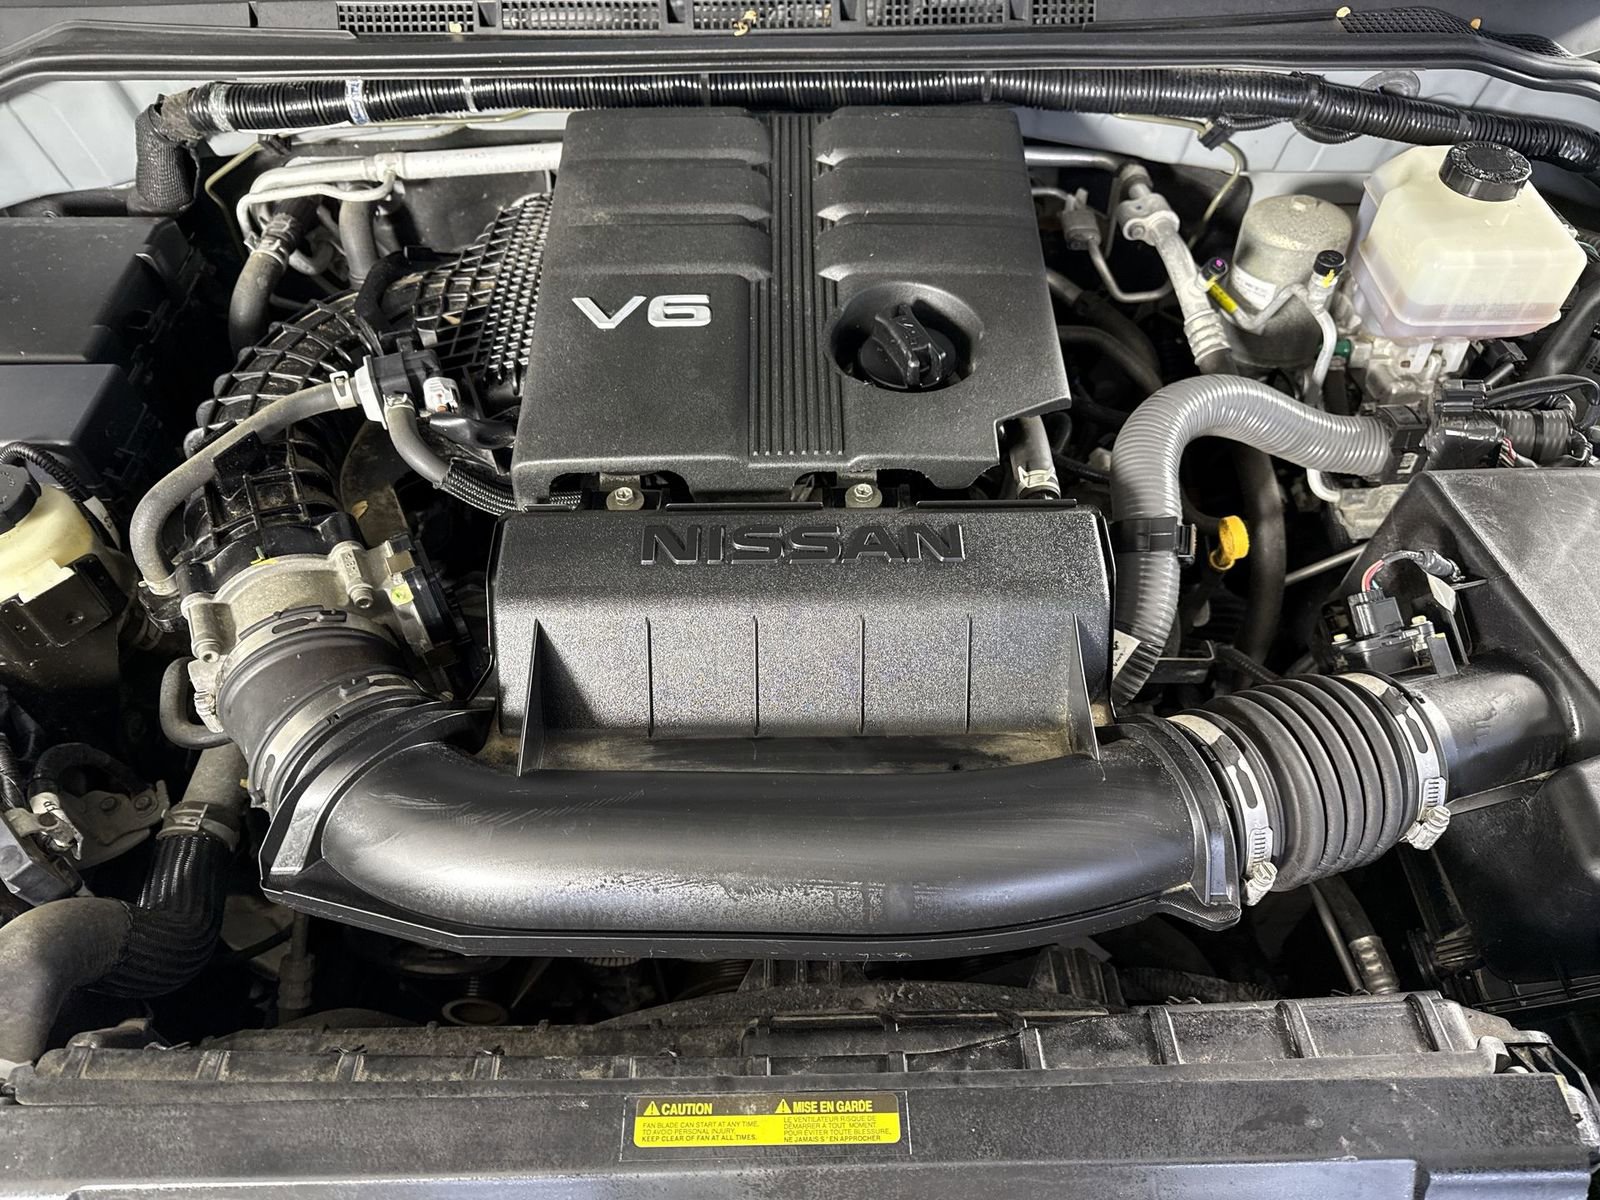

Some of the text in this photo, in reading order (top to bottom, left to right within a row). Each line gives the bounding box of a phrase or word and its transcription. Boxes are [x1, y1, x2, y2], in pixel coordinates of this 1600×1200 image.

[571, 294, 712, 329] V6
[640, 524, 966, 565] NISSAN
[661, 1102, 713, 1115] CAUTION
[792, 1100, 872, 1113] MISE EN GARDE
